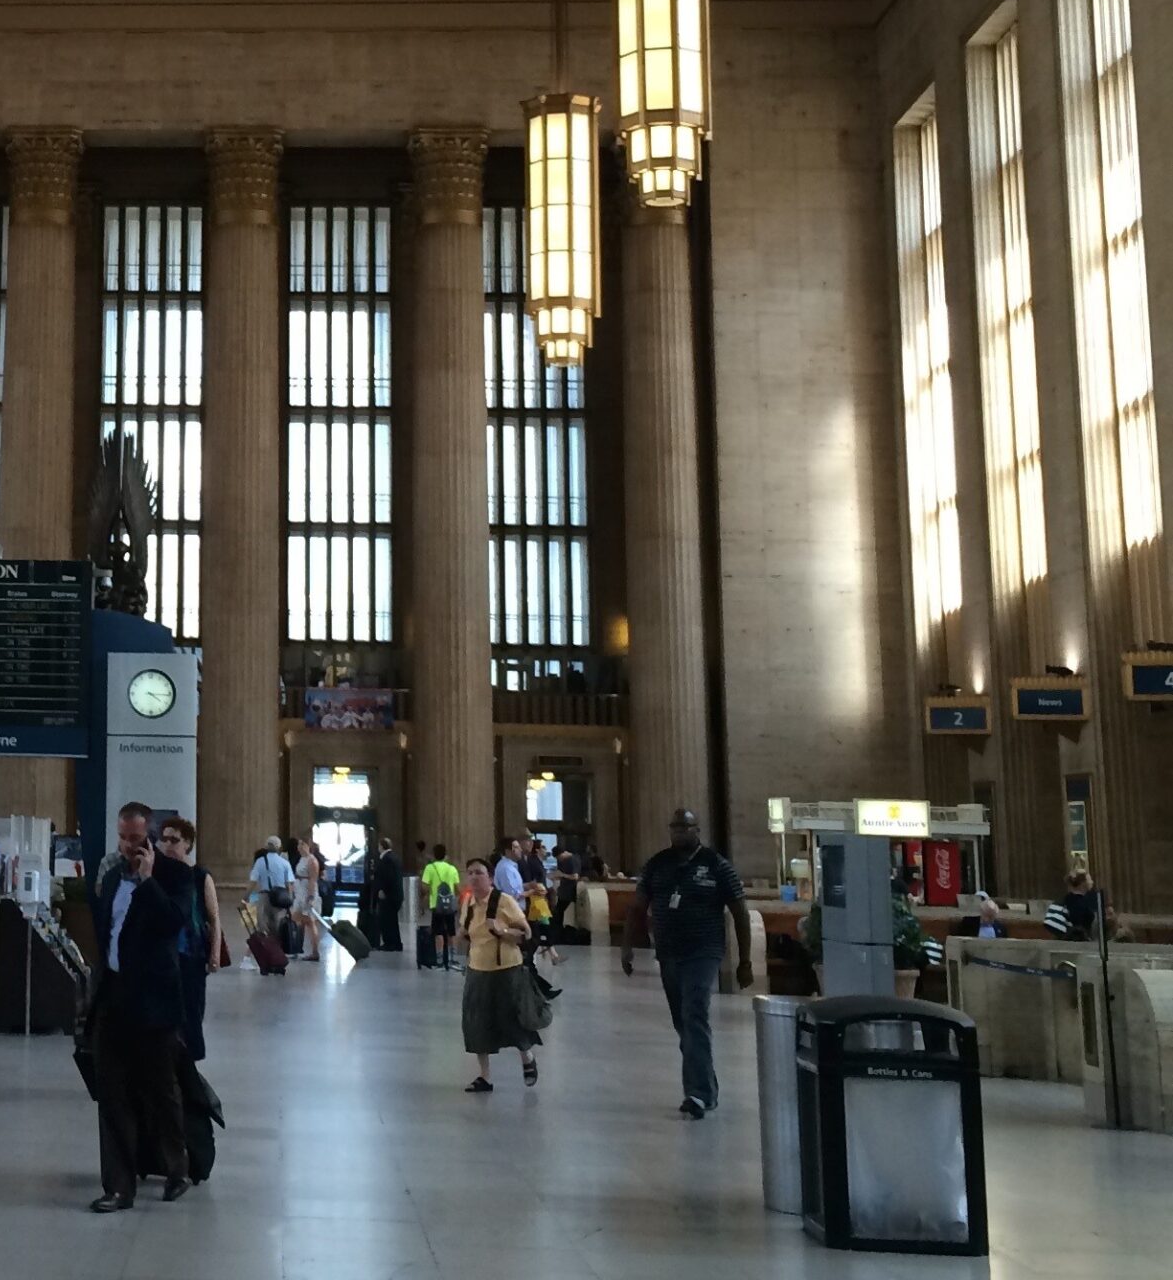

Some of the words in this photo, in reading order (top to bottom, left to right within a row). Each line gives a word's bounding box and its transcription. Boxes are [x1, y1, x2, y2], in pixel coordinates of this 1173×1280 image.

[1164, 671, 1173, 686] 4
[1038, 697, 1063, 708] News
[953, 711, 964, 726] 2
[119, 743, 184, 754] Information
[861, 819, 894, 827] Auntie
[867, 1066, 898, 1077] Bottles
[901, 1068, 909, 1077] &
[911, 1069, 934, 1078] Cans
